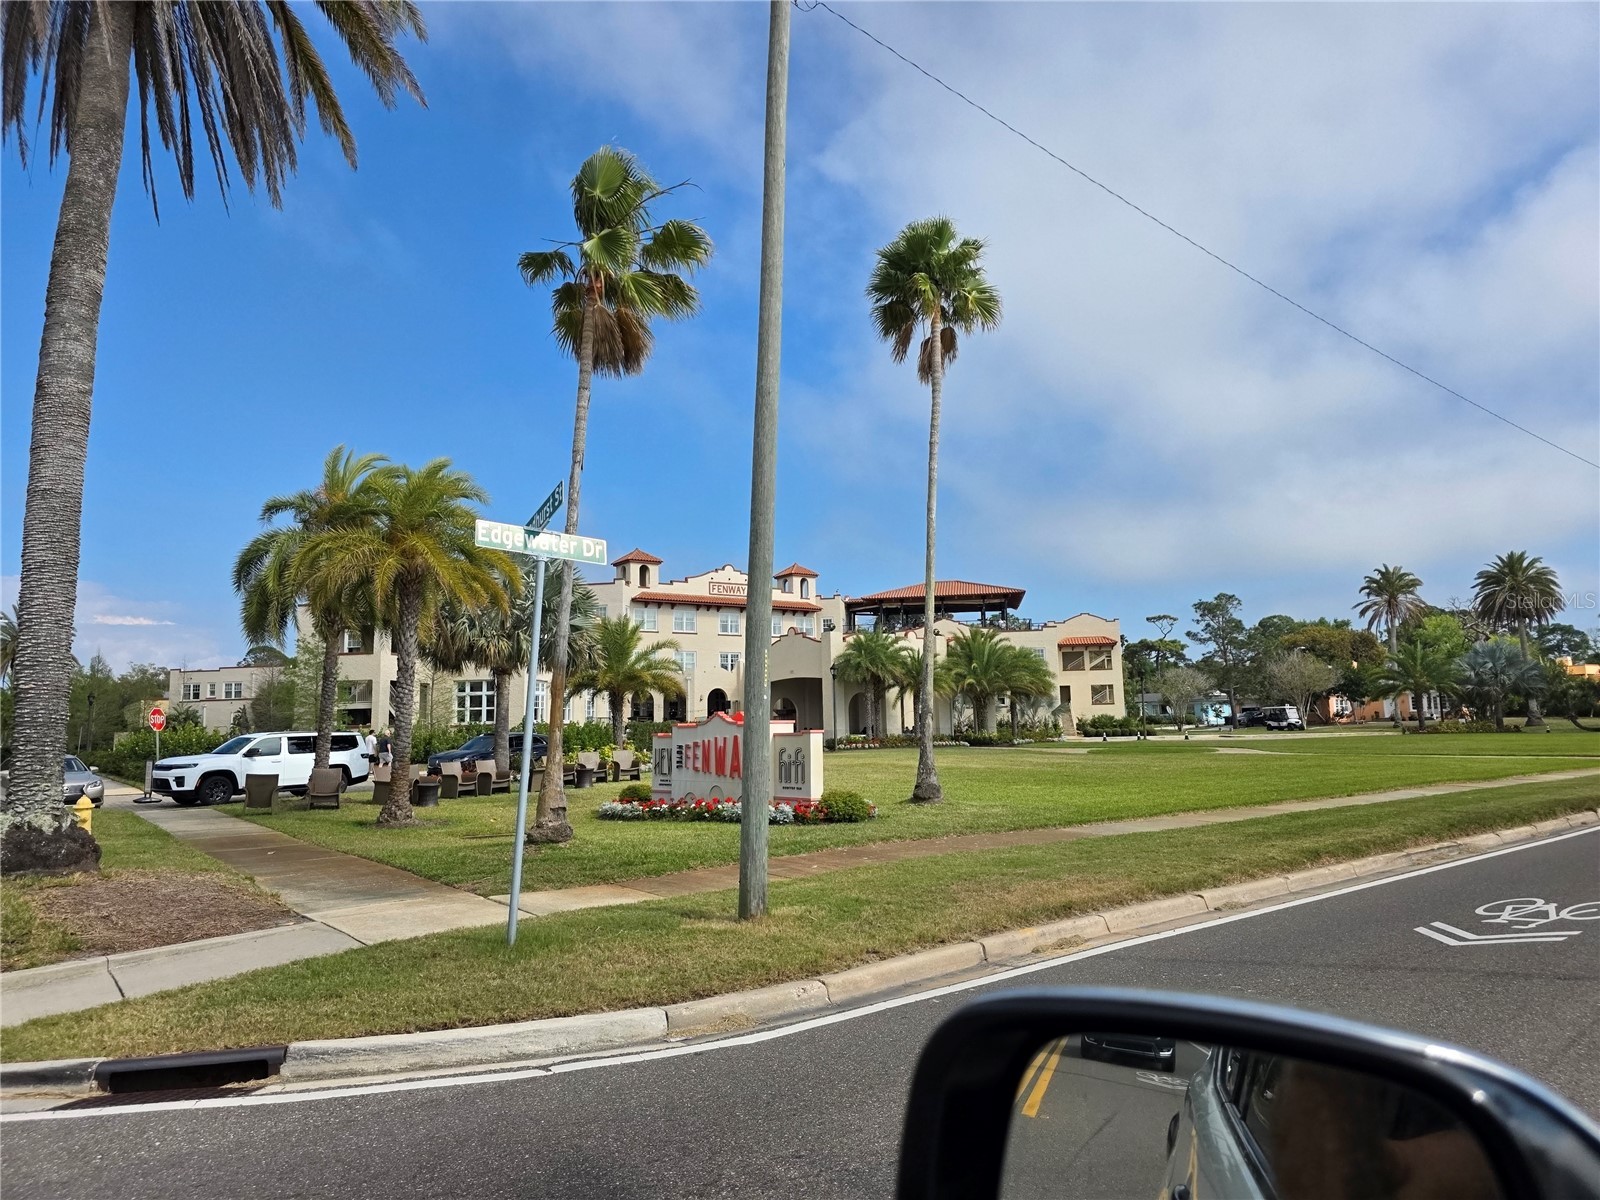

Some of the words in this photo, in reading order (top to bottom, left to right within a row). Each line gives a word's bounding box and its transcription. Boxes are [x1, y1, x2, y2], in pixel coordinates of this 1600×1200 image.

[554, 484, 563, 506] St
[479, 524, 578, 555] Edgewater
[582, 540, 603, 559] Dr
[711, 584, 747, 595] FENWAY
[150, 715, 165, 724] STOP
[684, 735, 742, 780] FENWA
